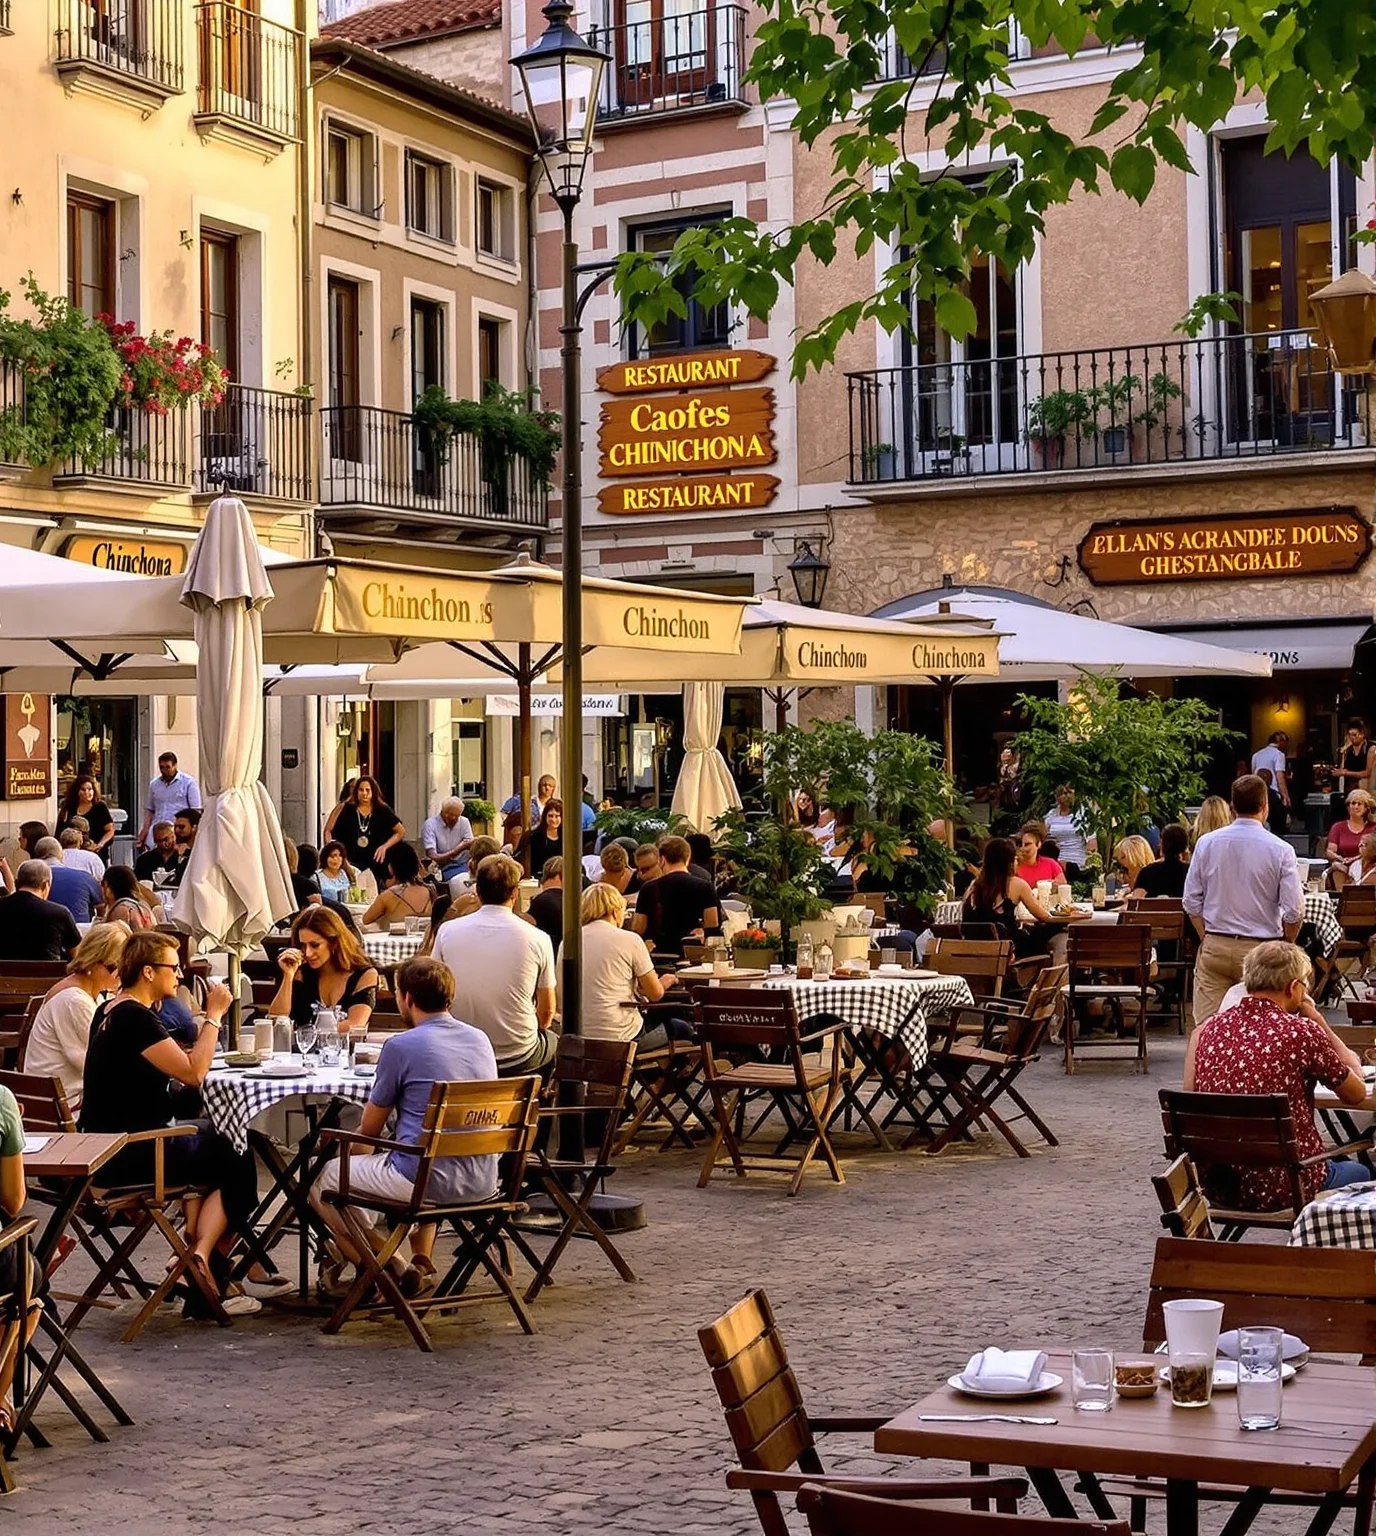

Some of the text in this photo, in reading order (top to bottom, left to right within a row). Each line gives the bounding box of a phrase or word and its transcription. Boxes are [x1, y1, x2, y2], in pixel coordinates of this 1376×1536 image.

[625, 358, 742, 387] RESTAURANT
[630, 398, 731, 432] Caofes
[623, 482, 755, 510] RESTAURANT
[623, 606, 710, 639] Chinchon
[912, 643, 986, 669] Chinchona
